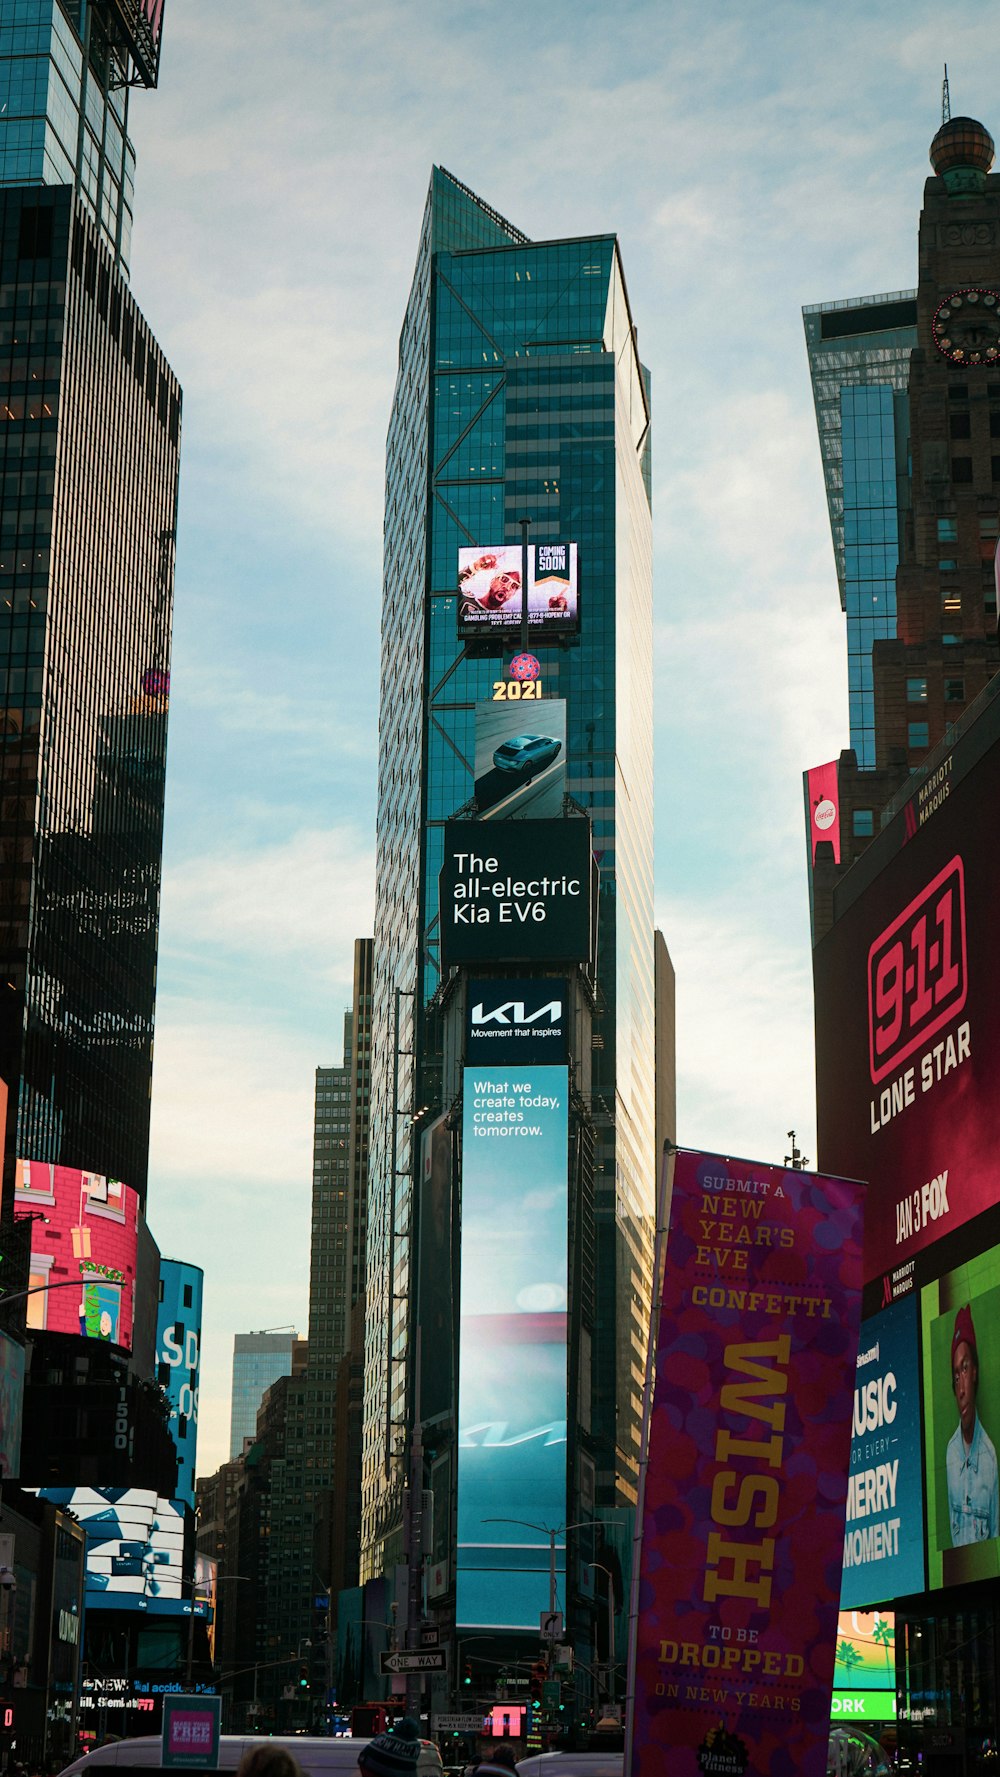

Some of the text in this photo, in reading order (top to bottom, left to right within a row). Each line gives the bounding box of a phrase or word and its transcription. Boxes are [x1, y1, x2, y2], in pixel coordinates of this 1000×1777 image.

[539, 546, 565, 557] COMING
[539, 556, 565, 571] SOON
[493, 681, 542, 700] 2021
[918, 755, 953, 805] MARRIOTT
[919, 782, 950, 827] MARQUIS
[453, 854, 499, 874] The
[453, 876, 580, 899] all-electric
[453, 902, 547, 924] Kia EV6
[471, 1028, 561, 1038] Movement that inspires
[474, 1082, 531, 1094] What we
[870, 1021, 971, 1135] LONE STAR
[473, 1096, 560, 1109] create today,
[473, 1111, 524, 1123] creates
[473, 1125, 543, 1137] tomorrow.
[703, 1176, 785, 1198] SUBMIT A
[700, 1195, 765, 1219] NEW
[896, 1170, 950, 1245] JAN 3 FOX
[699, 1220, 795, 1248] YEAR'S
[695, 1245, 748, 1270] EVE
[893, 1260, 915, 1283] MARRIOTT
[893, 1277, 913, 1297] MARQUIS
[692, 1286, 833, 1318] CONFETTI
[851, 1372, 897, 1438] USIC
[114, 1386, 129, 1450] 1500
[866, 1437, 889, 1459] EVERY
[703, 1334, 792, 1608] WISH
[842, 1517, 900, 1568] MOMENT
[708, 1625, 759, 1643] TO BE
[391, 1656, 438, 1667] ONE WAY
[658, 1639, 804, 1677] DROPPED
[655, 1682, 801, 1711] ON NEW YEAR'S
[173, 1727, 210, 1737] FREE
[701, 1751, 737, 1764] planet
[704, 1760, 744, 1774] fitness
